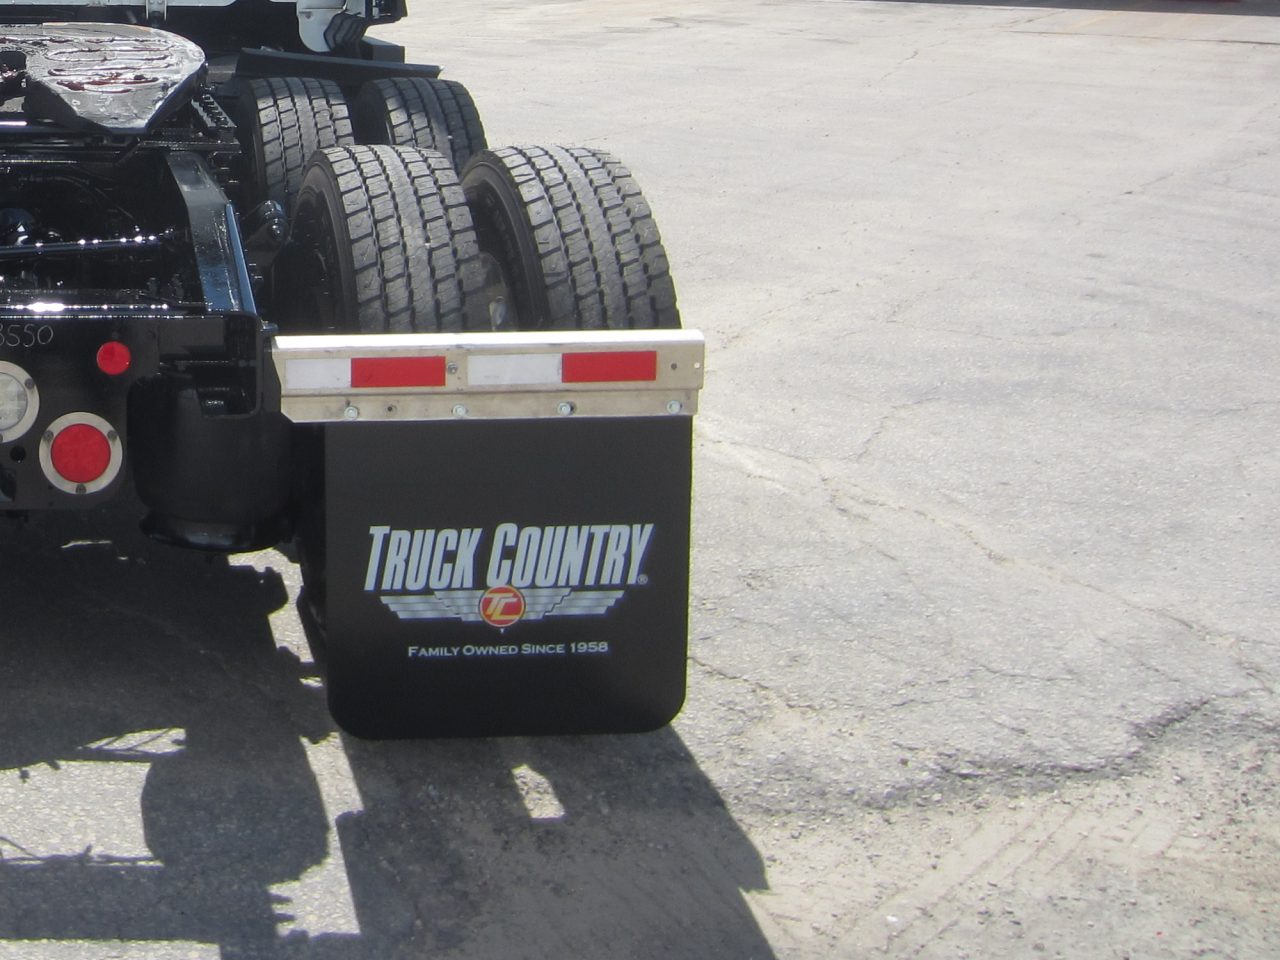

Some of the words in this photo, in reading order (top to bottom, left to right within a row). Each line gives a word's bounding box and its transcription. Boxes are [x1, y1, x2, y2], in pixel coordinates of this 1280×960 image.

[363, 525, 482, 591] TRUCK
[408, 644, 459, 658] FAMILY
[462, 644, 518, 657] OWNED
[521, 643, 565, 656] SINCE
[570, 641, 609, 654] 1958
